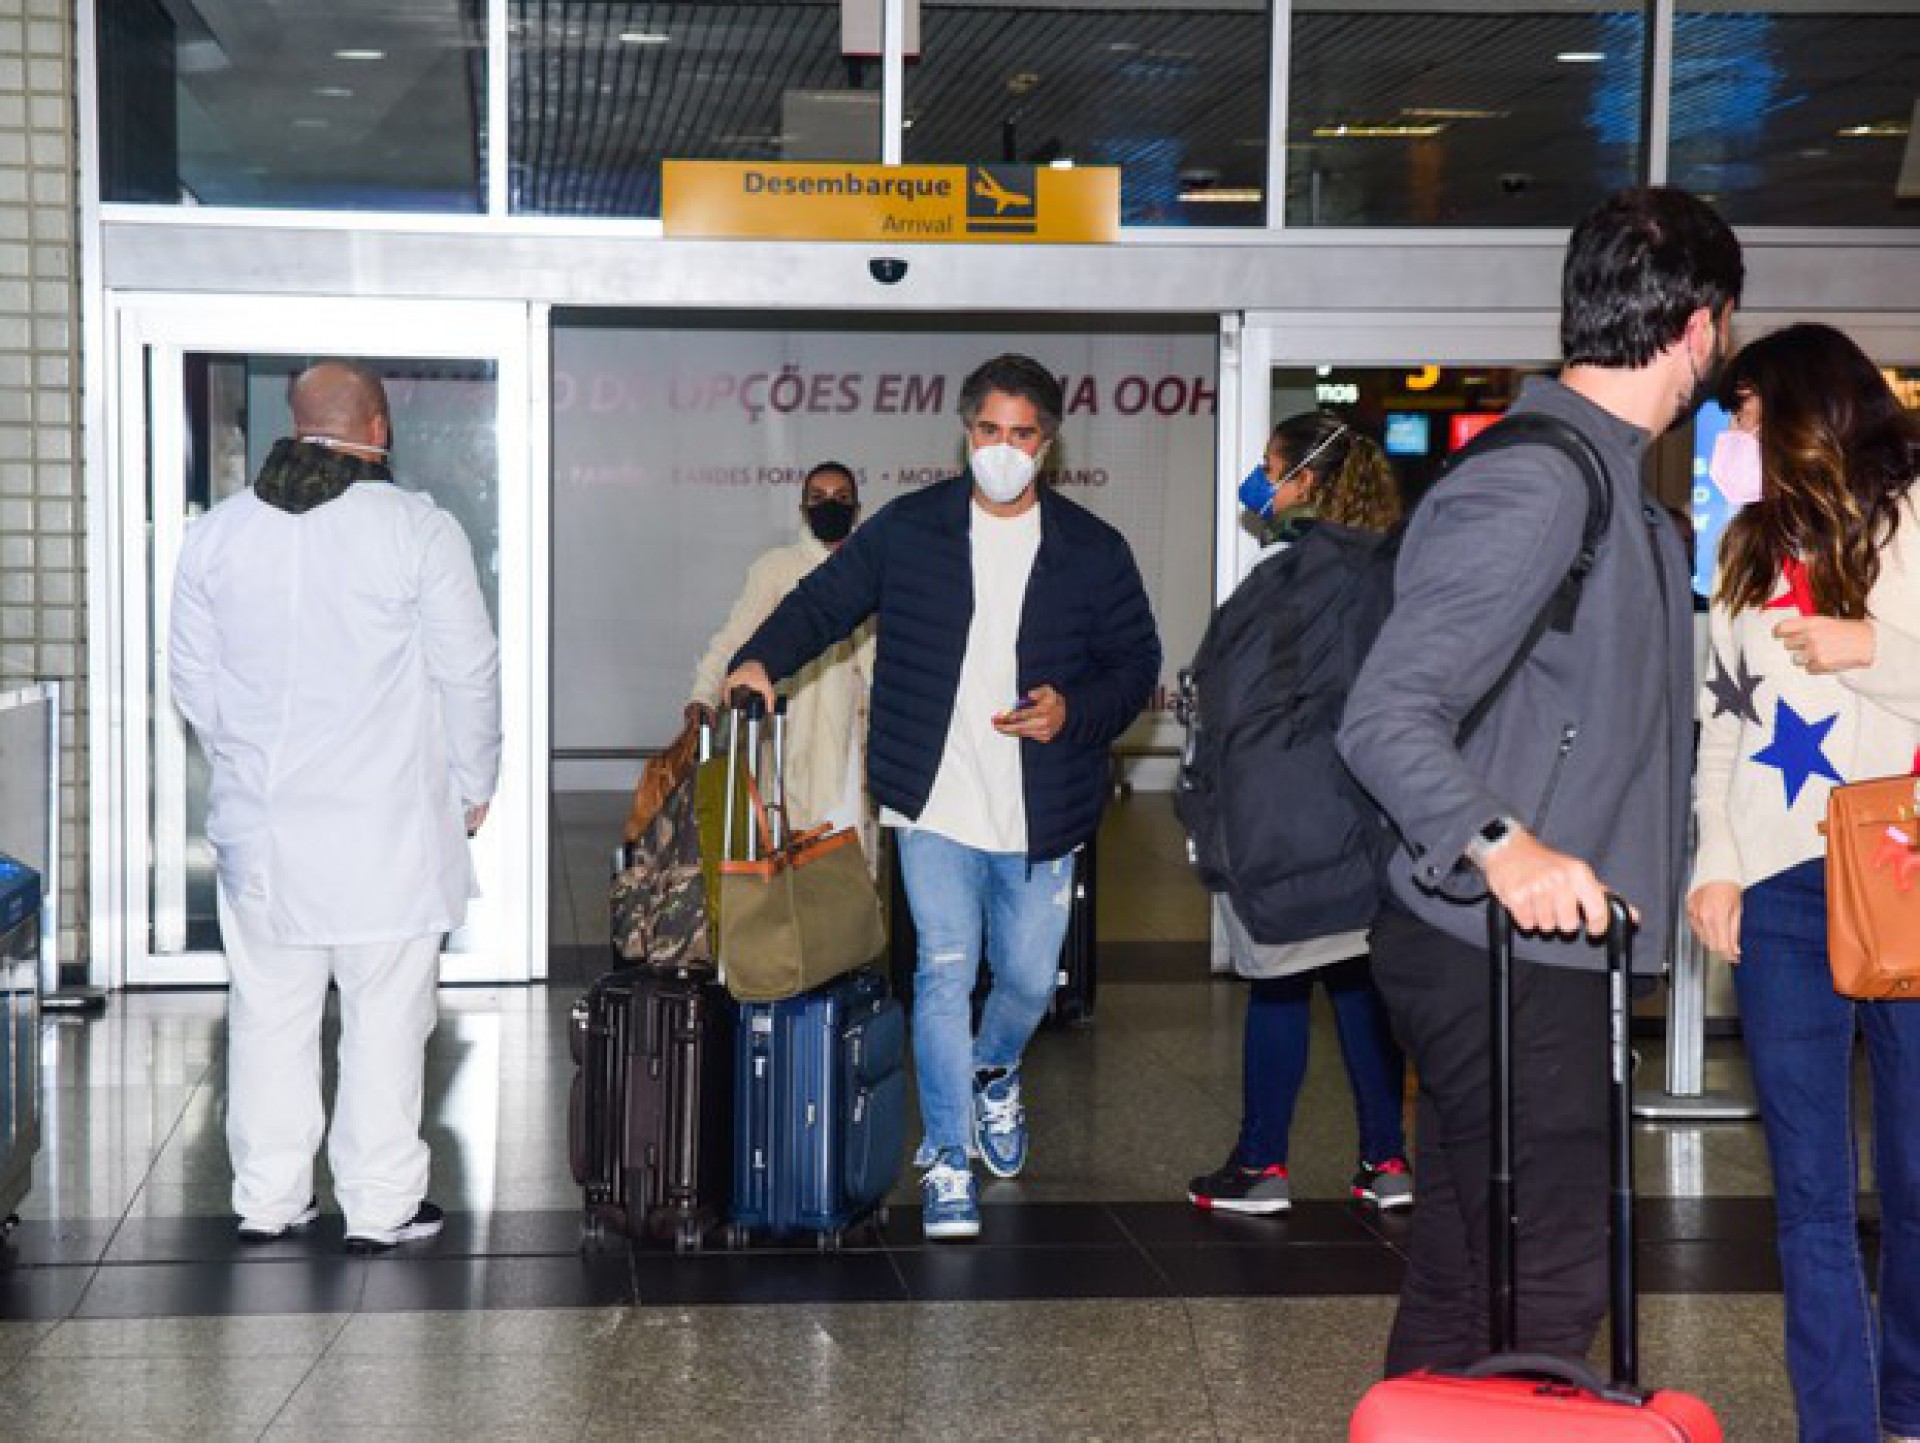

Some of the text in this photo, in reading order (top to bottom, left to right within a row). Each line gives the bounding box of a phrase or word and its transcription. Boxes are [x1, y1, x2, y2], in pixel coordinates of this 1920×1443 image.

[744, 172, 951, 201] Desembarque
[881, 213, 954, 233] Arrival
[873, 374, 945, 413] EM
[1114, 374, 1217, 414] OOH
